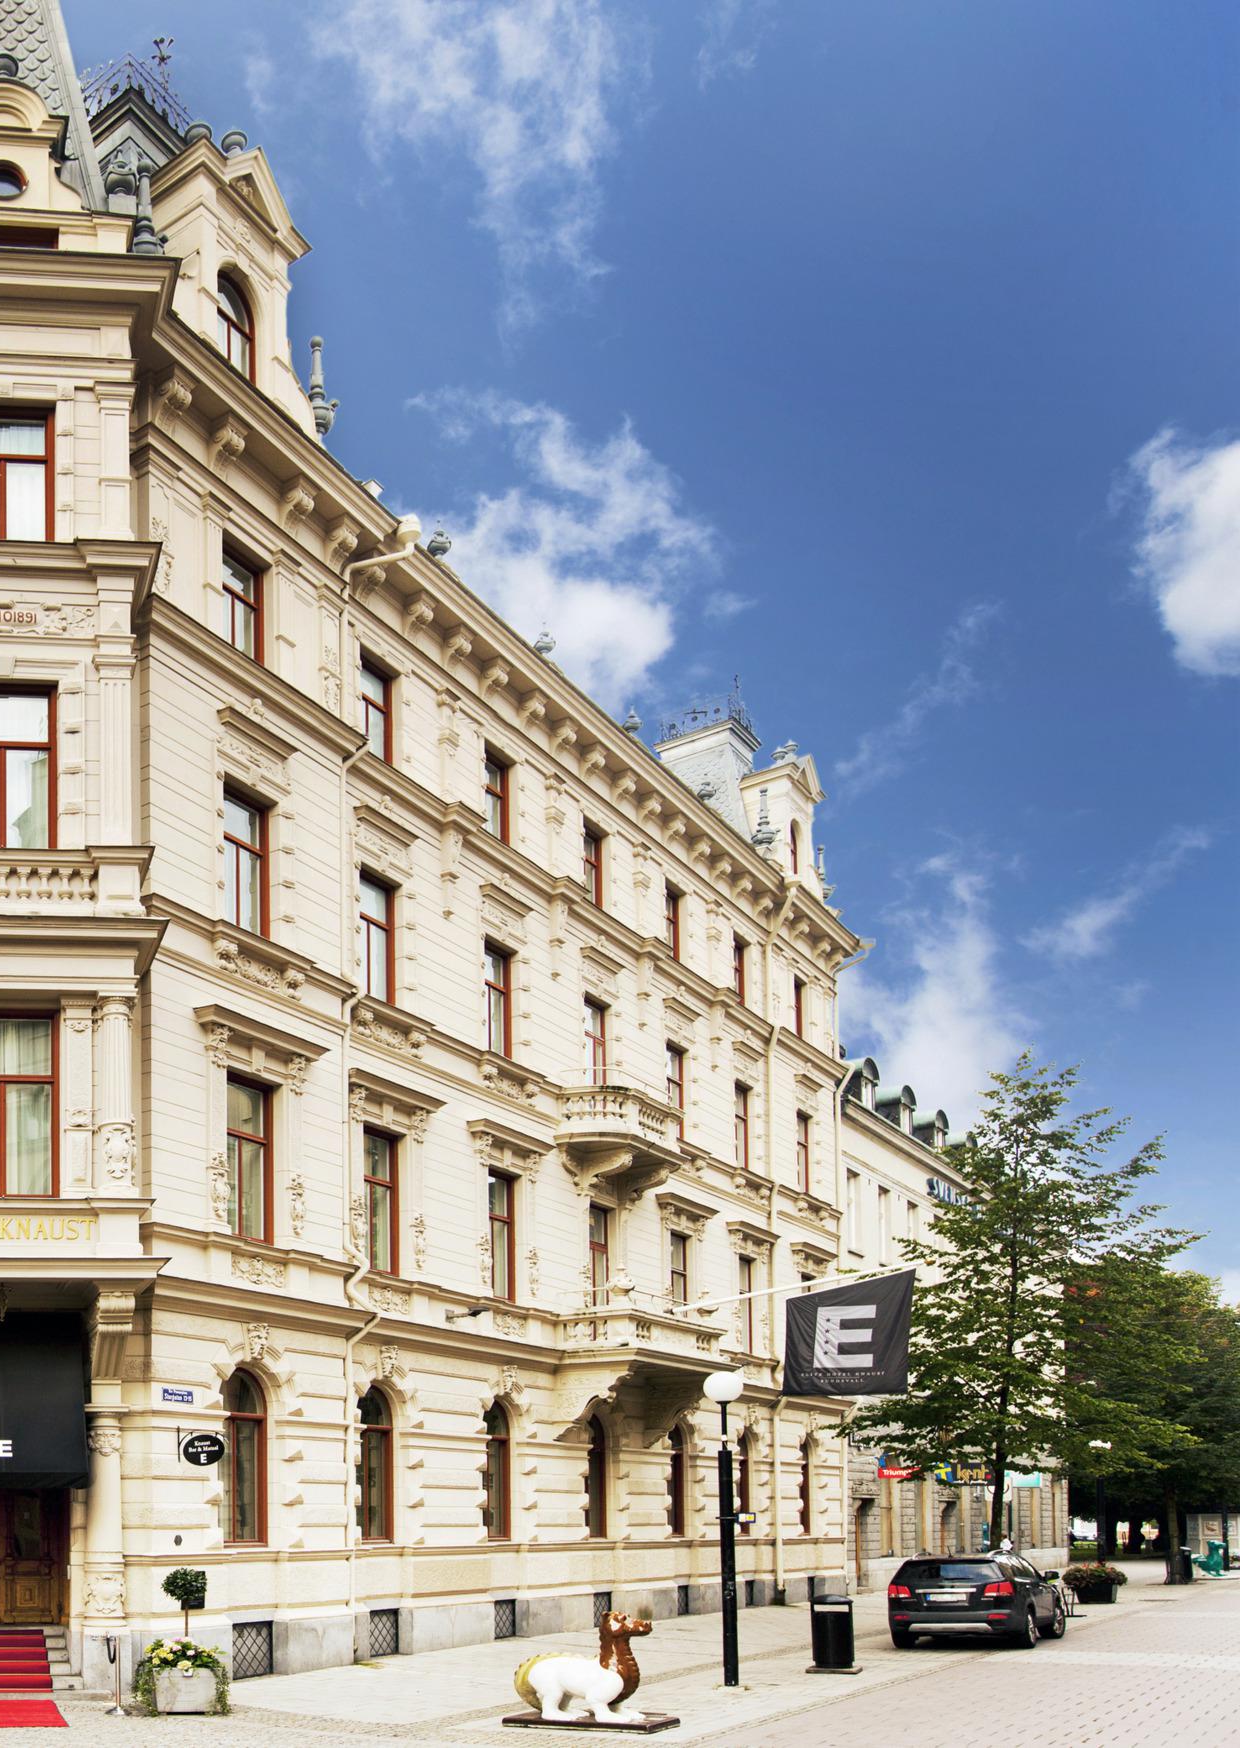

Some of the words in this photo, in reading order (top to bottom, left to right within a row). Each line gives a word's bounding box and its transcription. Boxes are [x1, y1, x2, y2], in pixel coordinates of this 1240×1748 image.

[0, 1216, 97, 1241] KNAUST
[813, 1304, 876, 1368] E
[200, 1453, 208, 1464] E
